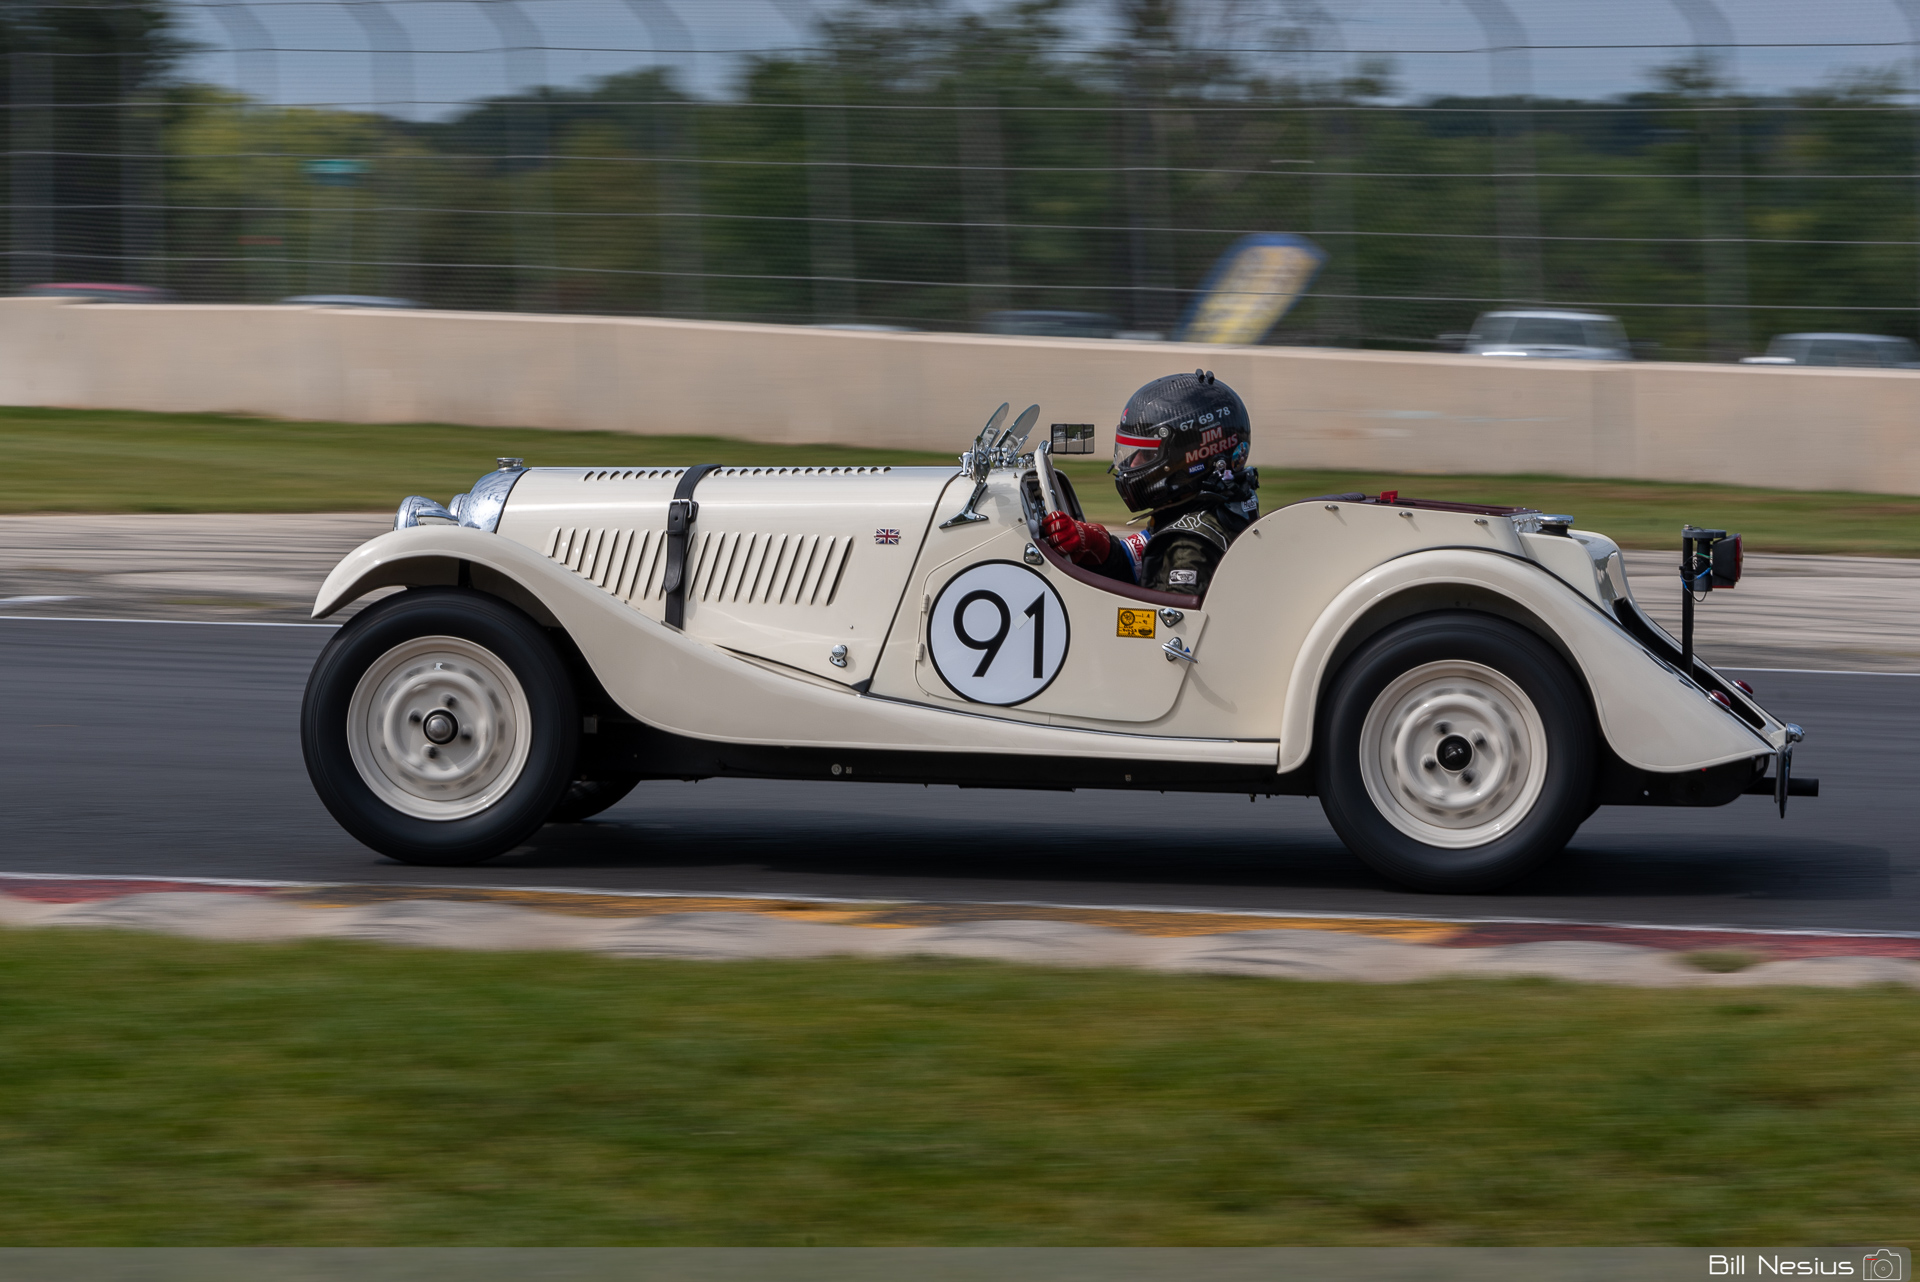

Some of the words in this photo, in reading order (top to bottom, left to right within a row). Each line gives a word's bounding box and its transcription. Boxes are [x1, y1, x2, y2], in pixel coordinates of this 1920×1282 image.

[1180, 420, 1194, 431] 67
[1199, 413, 1214, 424] 69
[1216, 407, 1230, 418] 78
[1185, 434, 1238, 463] MORRIS
[1200, 426, 1222, 446] JIM
[953, 589, 1045, 679] 91
